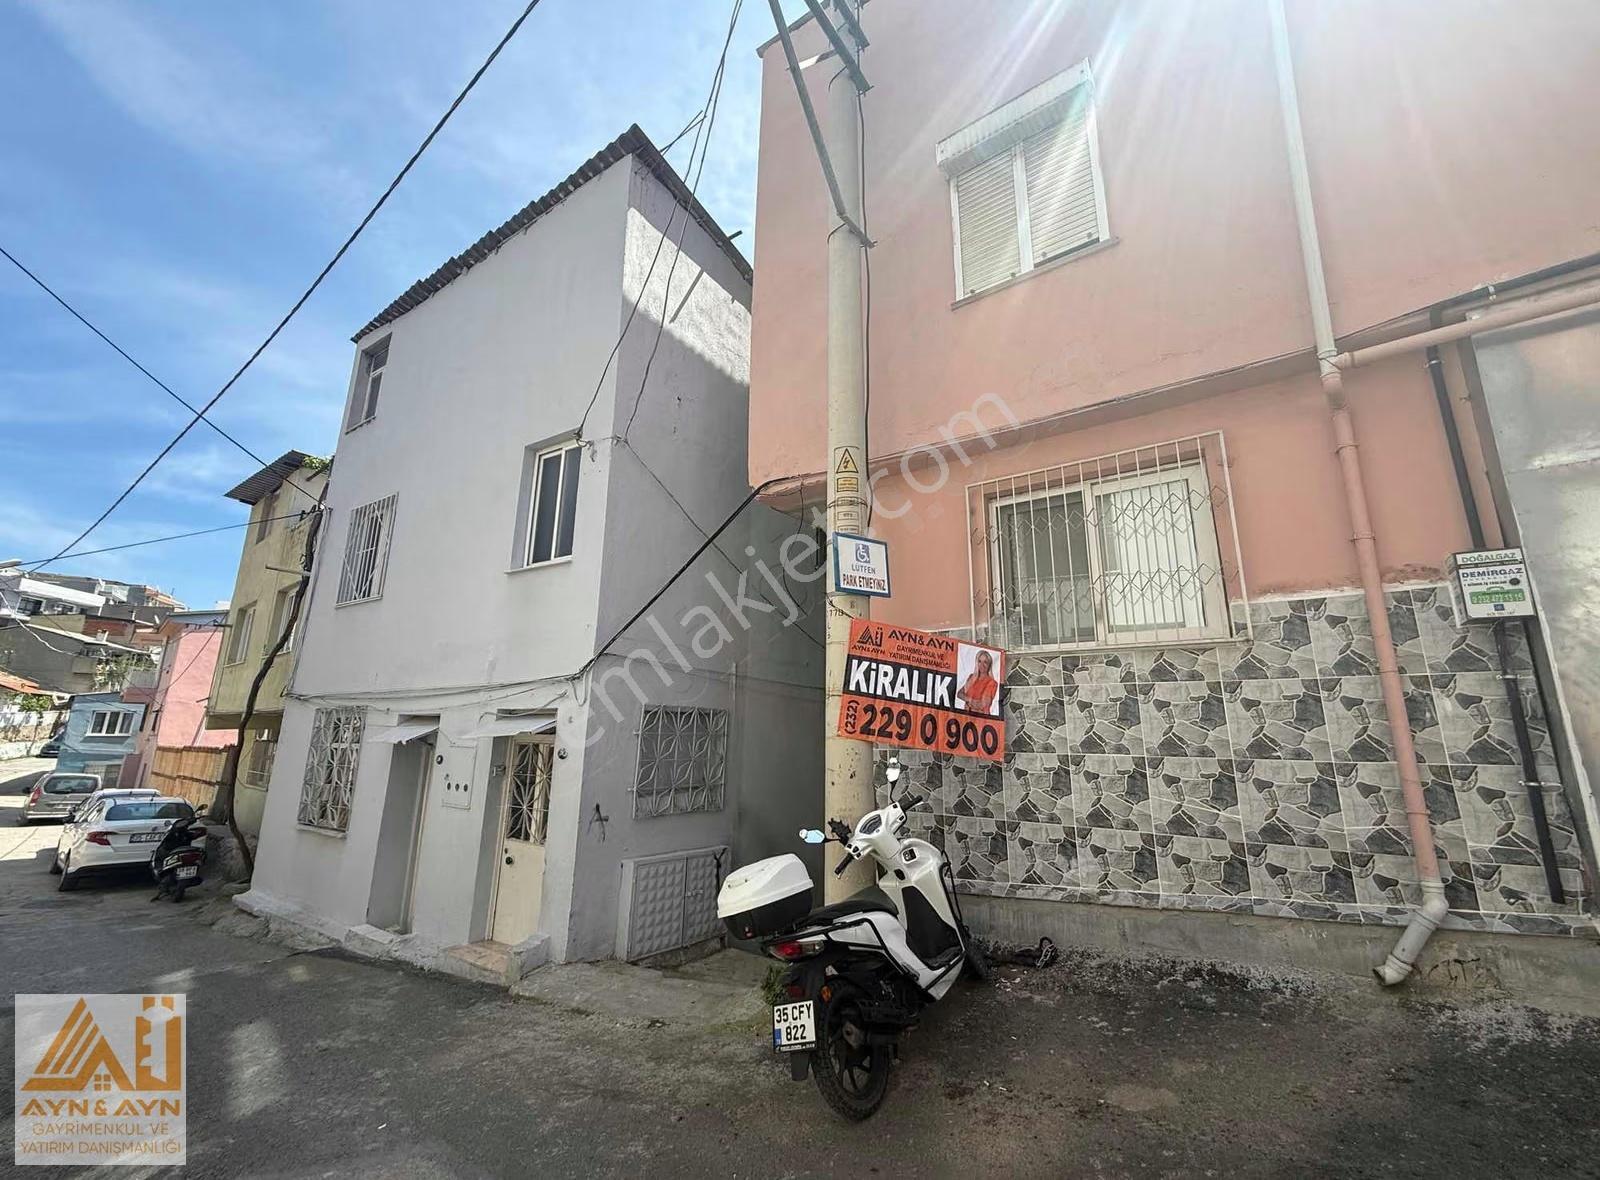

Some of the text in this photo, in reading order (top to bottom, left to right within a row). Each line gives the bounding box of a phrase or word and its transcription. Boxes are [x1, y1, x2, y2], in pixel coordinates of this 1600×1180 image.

[1461, 552, 1516, 563] DOĞALGAZ
[851, 563, 876, 574] LÜTFEN
[1462, 567, 1524, 578] DEMİRGAZ
[842, 573, 857, 587] PARK
[844, 700, 860, 735] (232)
[859, 703, 999, 756] 229 0 900
[776, 1003, 812, 1023] 35 CFY
[785, 1024, 806, 1041] 822
